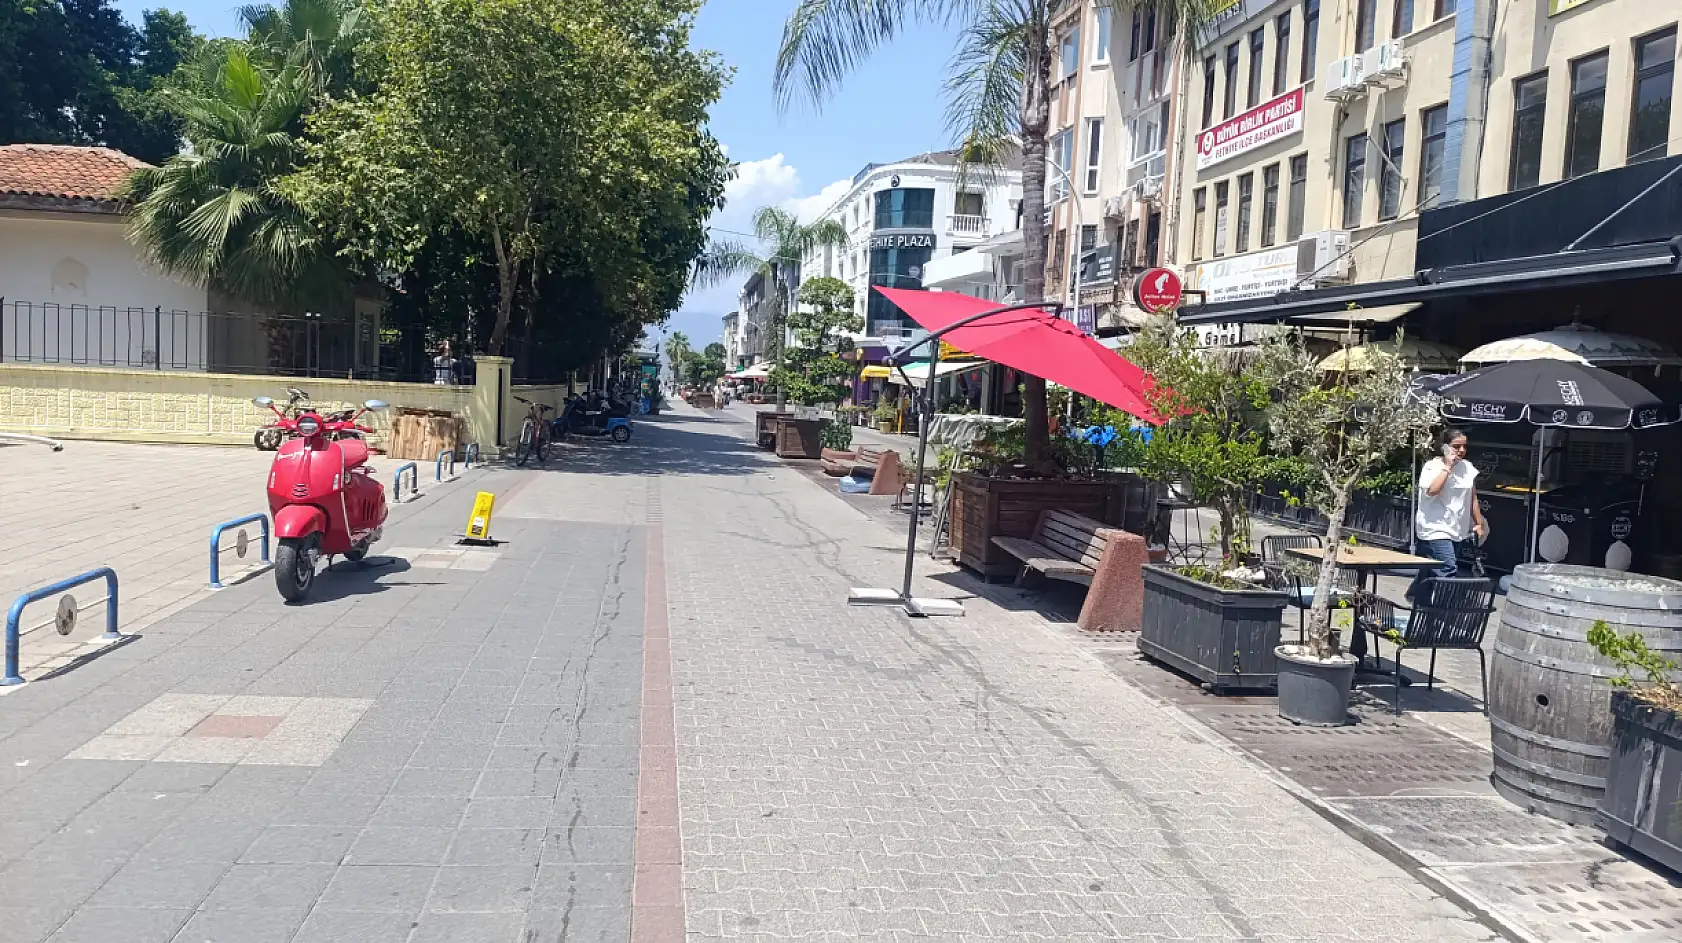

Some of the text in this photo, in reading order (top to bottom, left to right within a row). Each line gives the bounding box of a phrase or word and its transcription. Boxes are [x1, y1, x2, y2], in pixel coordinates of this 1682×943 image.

[1216, 94, 1296, 144] BÜYÜK BİRLİK PARTİSİ
[897, 235, 932, 247] PLAZA
[1205, 332, 1236, 345] Game
[1556, 380, 1575, 405] KECHY
[1471, 403, 1507, 413] KECHY
